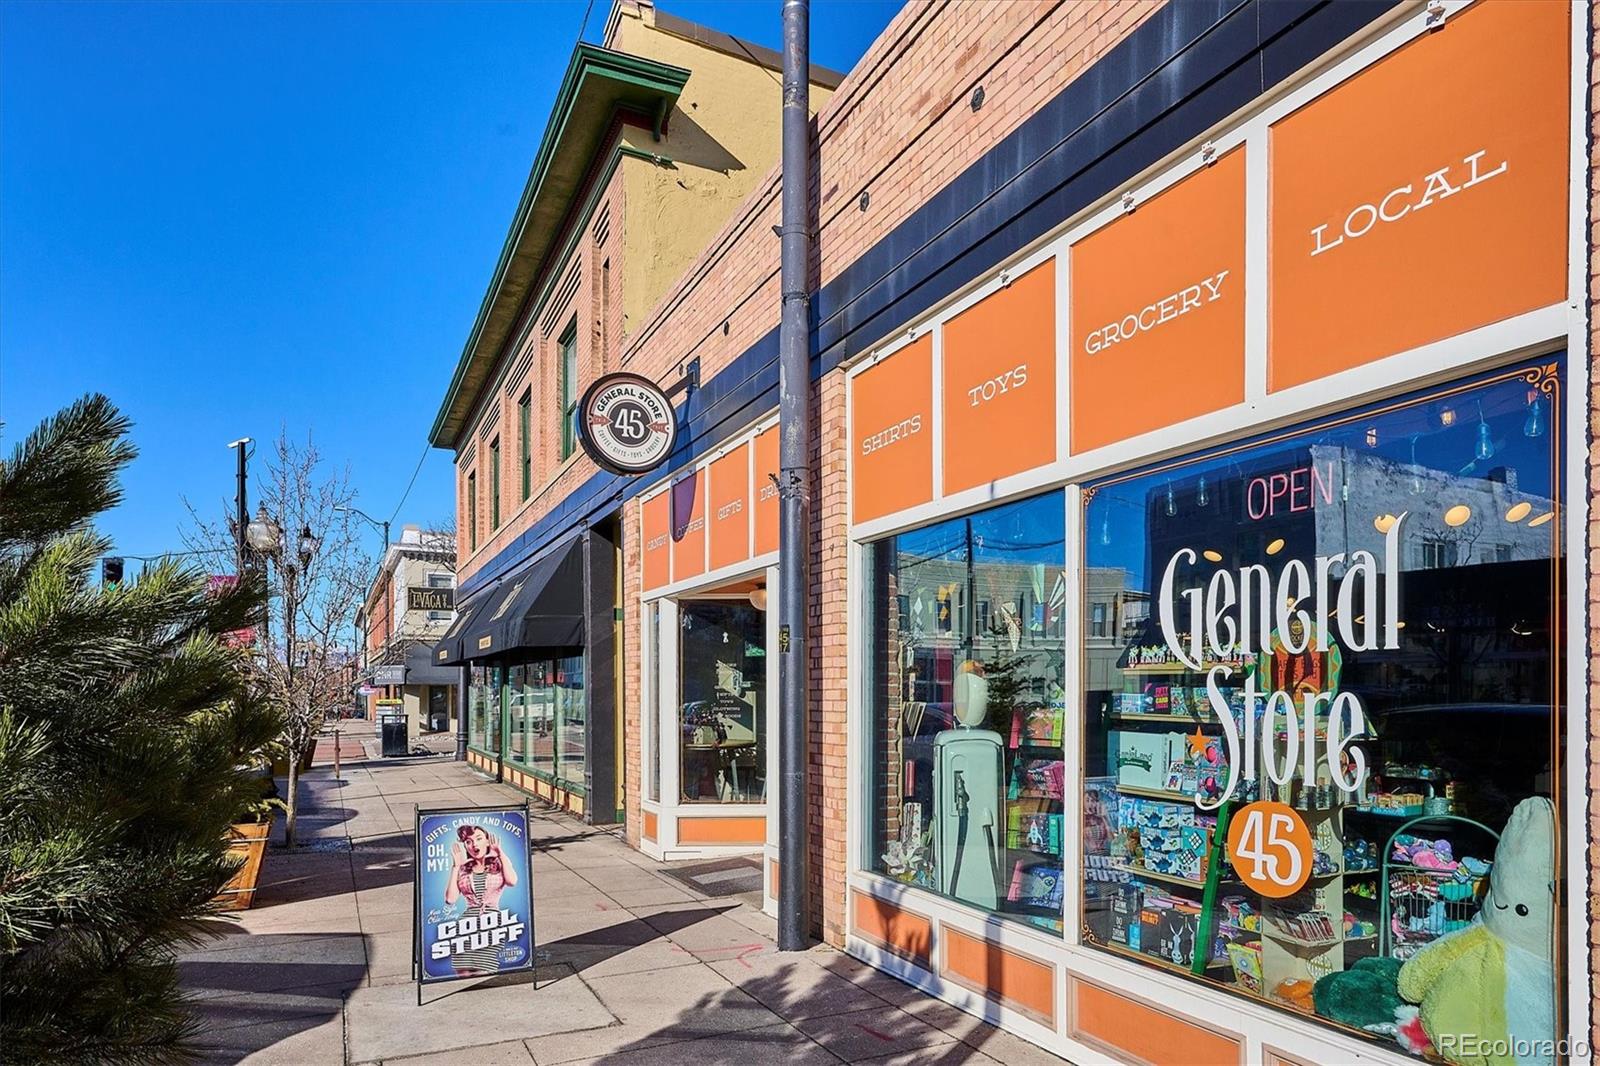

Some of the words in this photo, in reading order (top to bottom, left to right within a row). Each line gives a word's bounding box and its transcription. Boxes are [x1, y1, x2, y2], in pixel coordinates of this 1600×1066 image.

[1310, 149, 1507, 256] LOCAL
[1085, 271, 1229, 355] GROCERY
[597, 388, 636, 412] GENERAL
[638, 392, 662, 419] STORE
[968, 365, 1027, 407] TOYS
[614, 408, 645, 439] 45
[862, 414, 922, 456] SHIRTS
[717, 499, 743, 521] GIFTS
[1247, 463, 1333, 520] OPEN
[1159, 510, 1408, 671] General
[1195, 665, 1365, 811] Store
[452, 816, 481, 827] CANDY
[483, 816, 500, 827] AND
[427, 859, 449, 872] MY!
[1236, 810, 1302, 886] 45
[431, 923, 525, 960] STUFF
[437, 909, 519, 940] COOL
